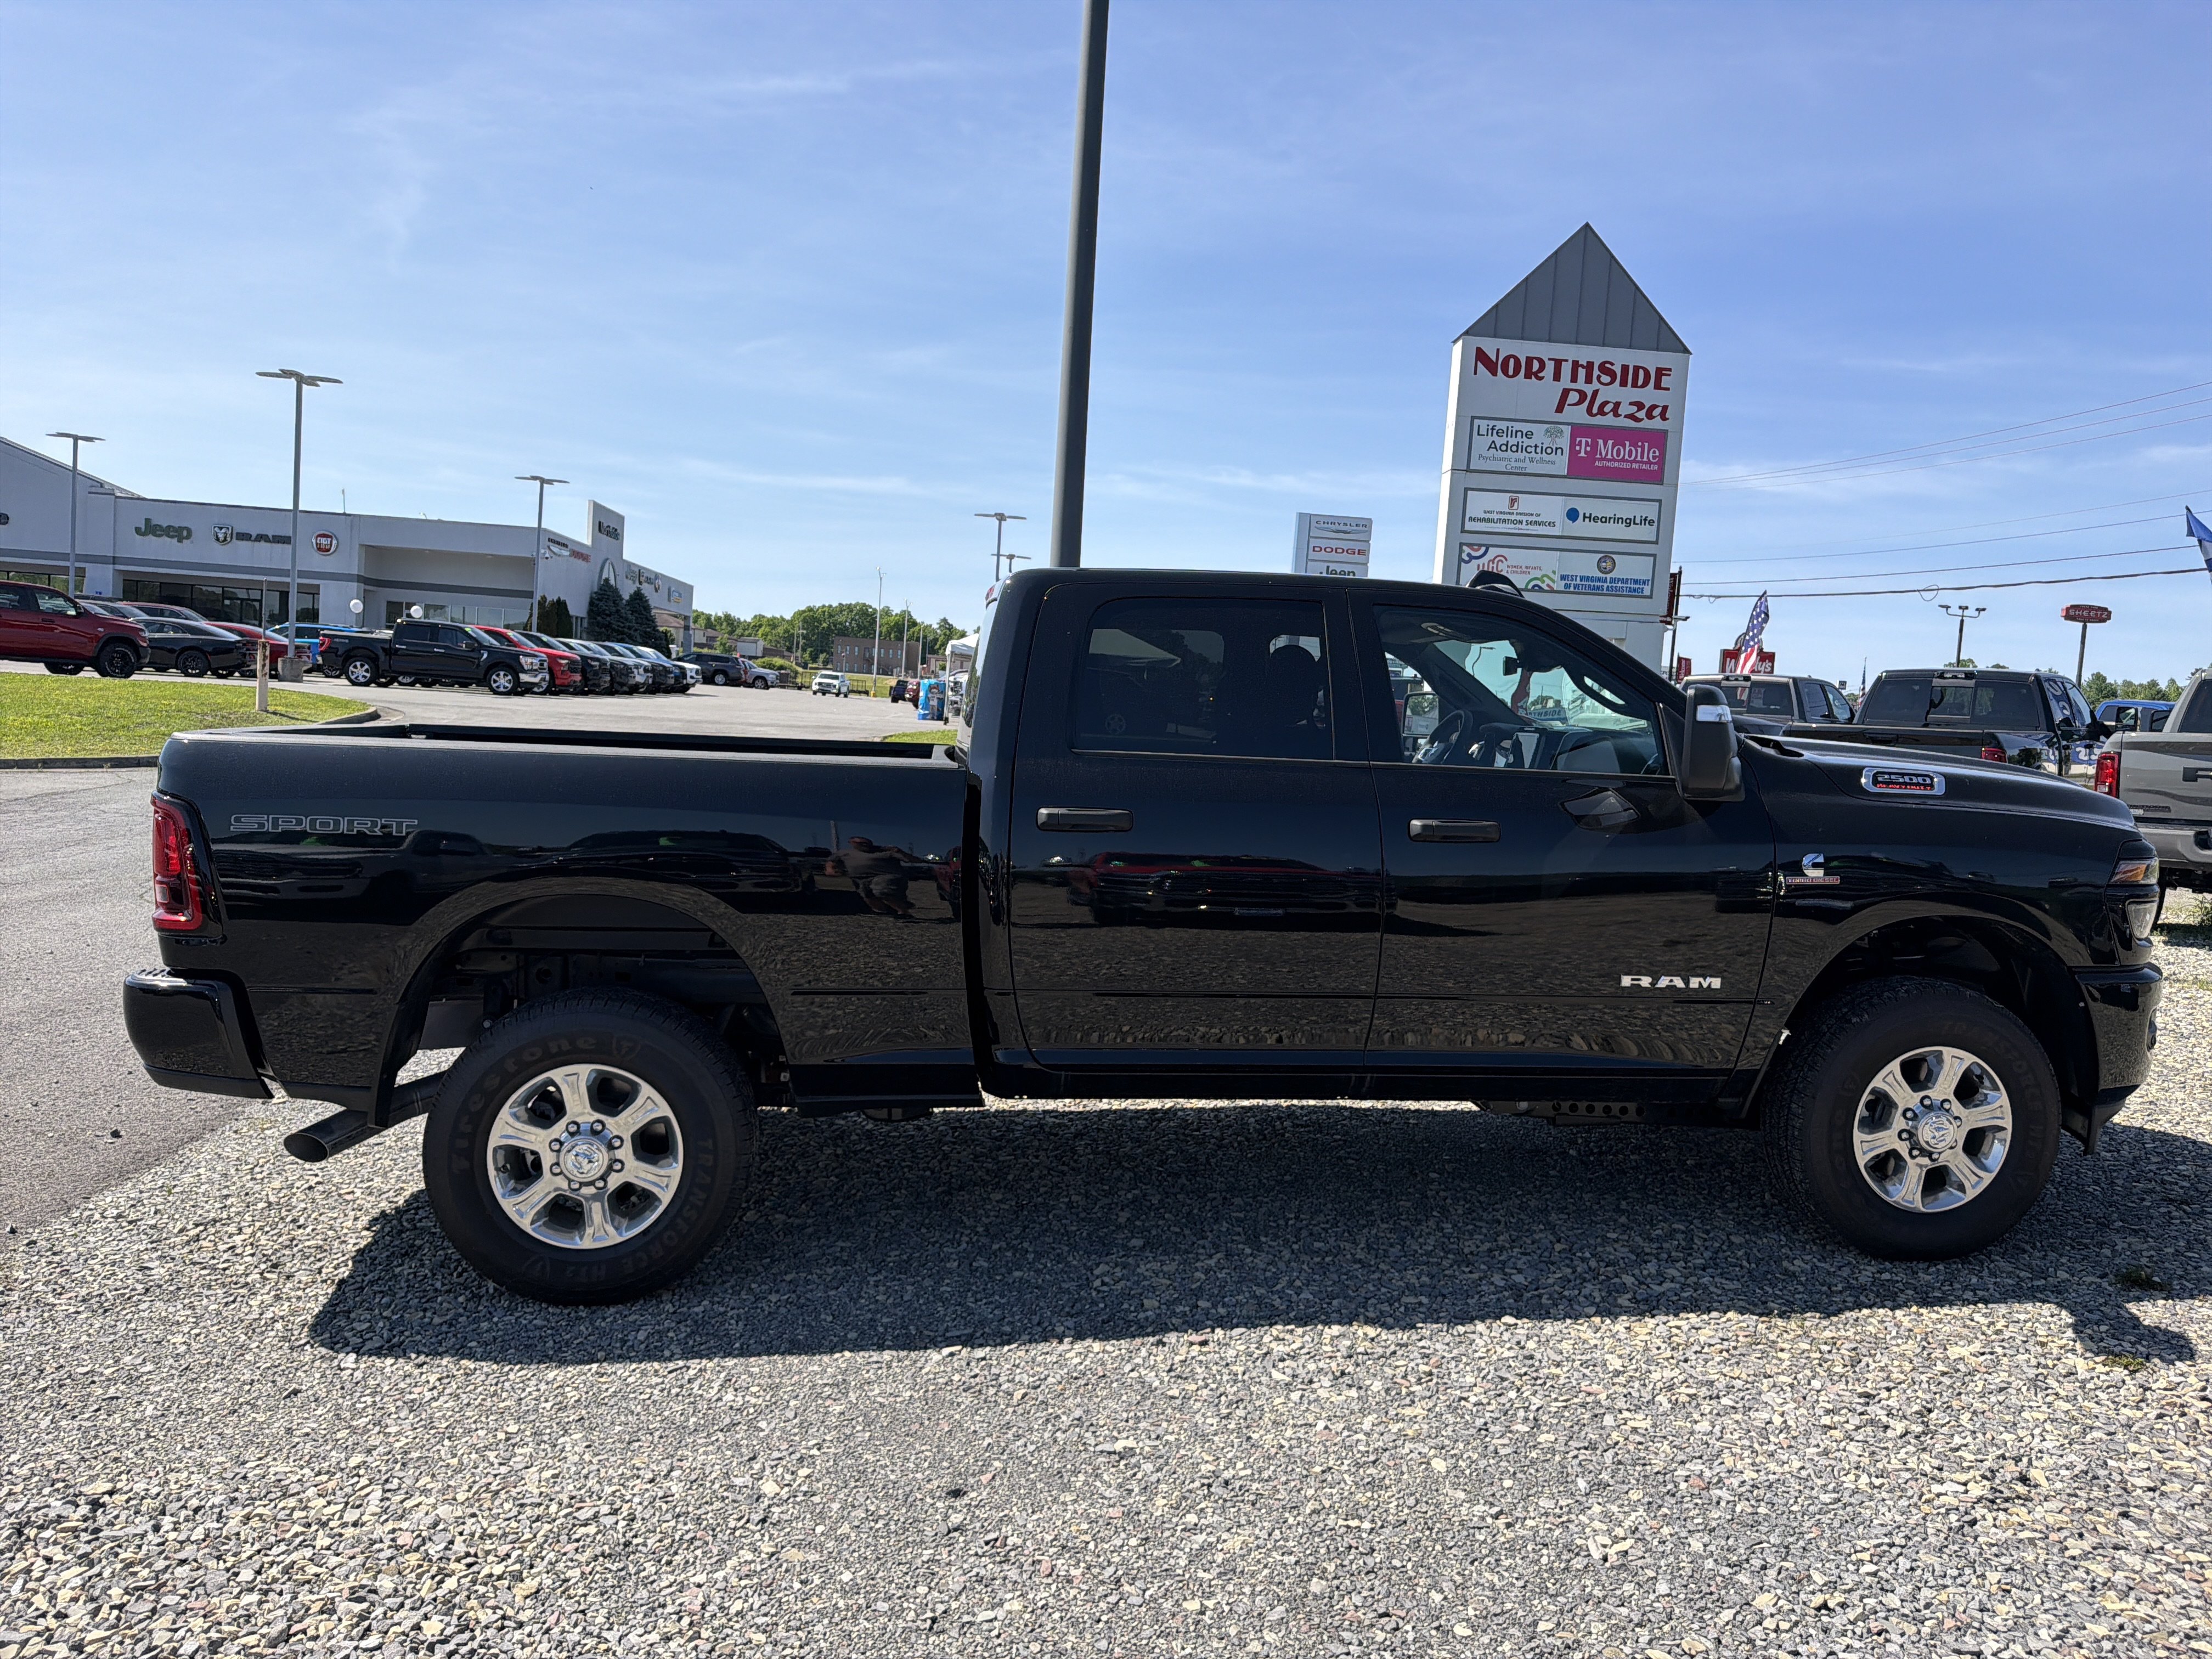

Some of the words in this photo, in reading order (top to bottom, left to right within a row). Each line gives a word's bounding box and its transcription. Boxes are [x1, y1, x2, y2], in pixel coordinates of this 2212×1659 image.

[1474, 347, 1672, 391] NORTHSIDE
[1554, 388, 1669, 422] Plaza
[1477, 424, 1534, 439] Lifeline
[1486, 440, 1564, 456] Addiction
[1595, 438, 1660, 462] Mobile
[1478, 454, 1513, 463] Psychiatric
[1528, 456, 1556, 465] Wellness
[1594, 460, 1631, 469] AUTHORIZED
[1468, 516, 1523, 526] REHABILITATION
[1582, 512, 1655, 528] HearingLife
[134, 517, 193, 543] Jeep
[235, 532, 291, 545] RAM
[1312, 545, 1367, 556] DODGE
[1560, 574, 1578, 582] WEST
[1579, 575, 1608, 584] VIRGINIA
[1609, 577, 1650, 586] DEPARTMENT
[1573, 583, 1605, 592] VETERANS
[1605, 585, 1645, 594] ASSISTANCE
[2069, 609, 2108, 618] SHEETZ
[1876, 774, 1932, 784] 2500
[230, 814, 418, 836] SPORT
[1620, 974, 1722, 989] RAM
